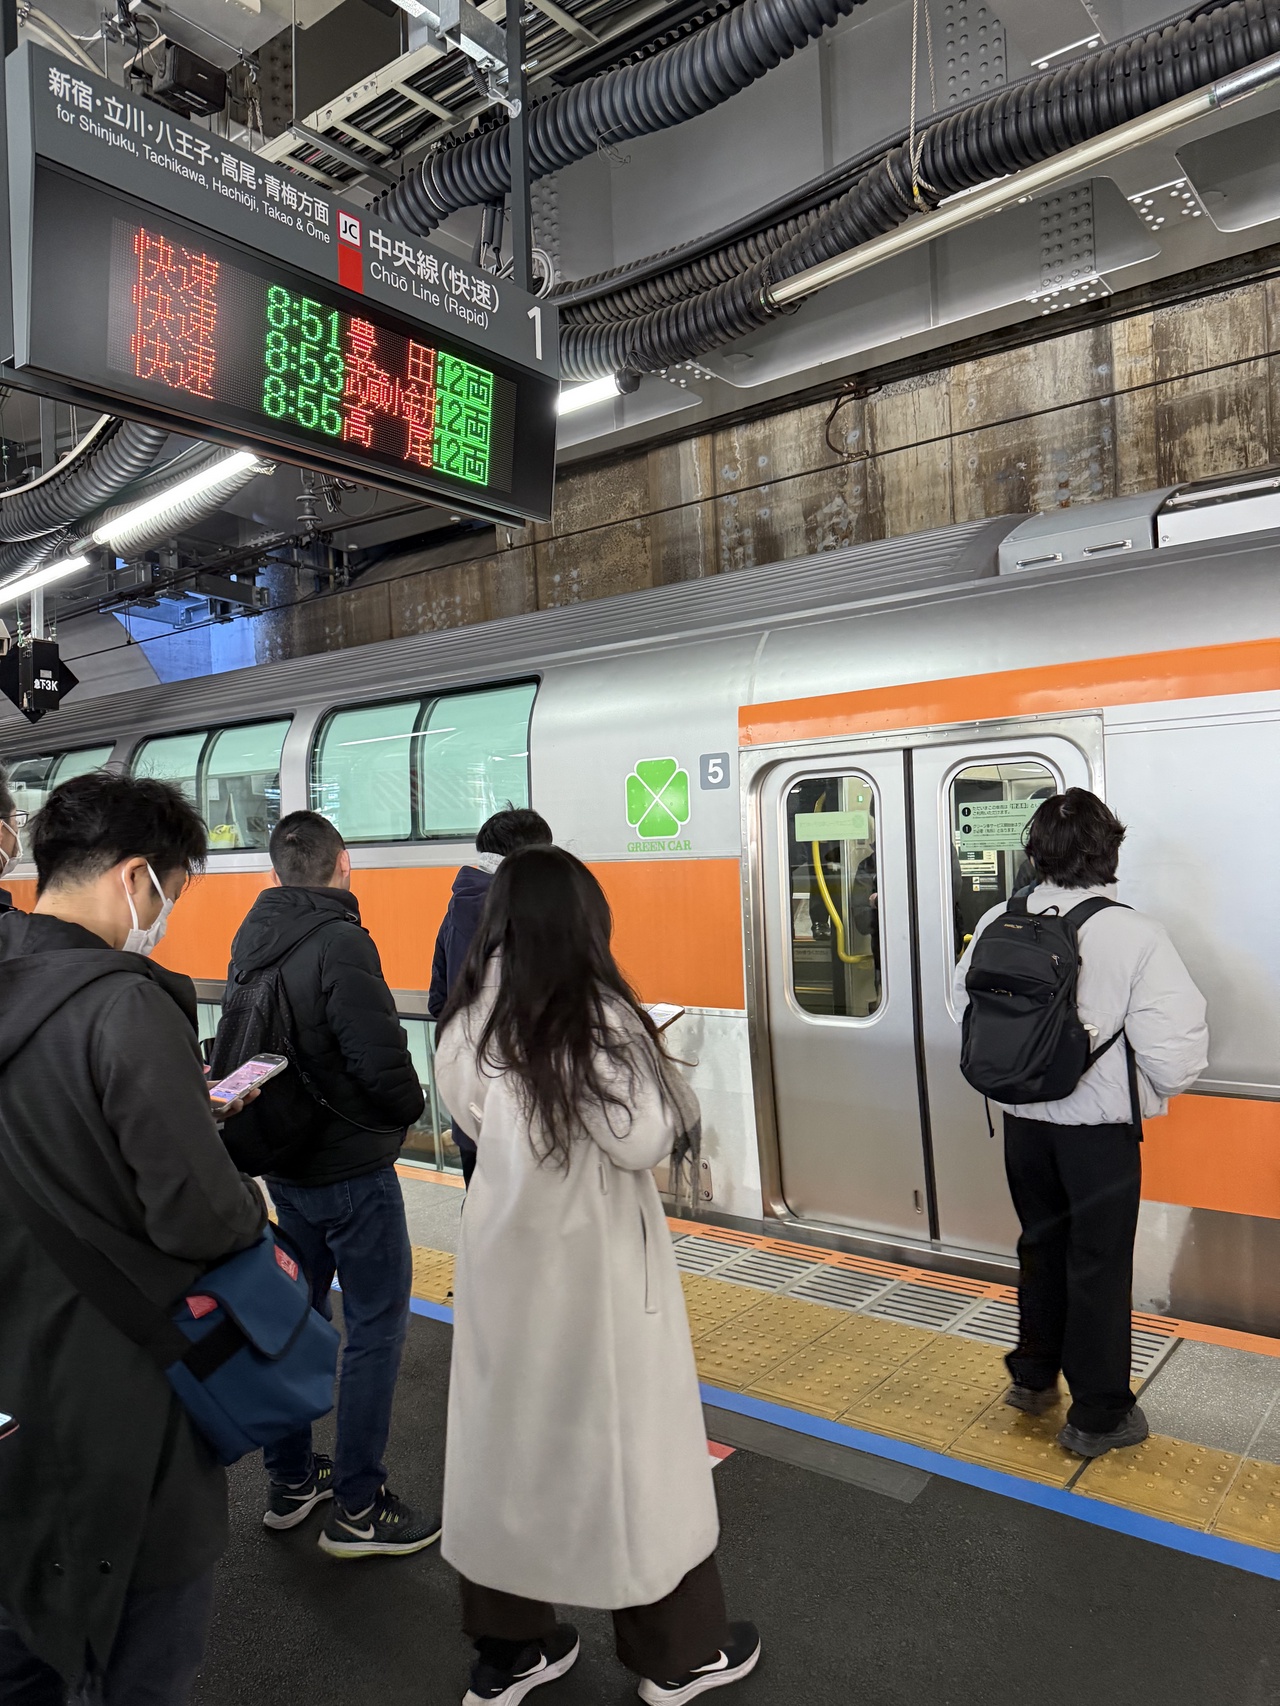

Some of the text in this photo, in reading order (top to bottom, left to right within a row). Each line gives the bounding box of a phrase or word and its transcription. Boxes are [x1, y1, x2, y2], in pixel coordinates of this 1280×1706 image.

[48, 67, 329, 226] 新宿・立川・八王子・高尾・青梅方面
[56, 104, 330, 243] for Shinjuku, Tachikawa, Hachiōji, Takao & Ōme
[342, 220, 358, 240] JC
[134, 228, 220, 306] 快速
[267, 285, 341, 350] 8:51
[437, 354, 493, 407] 12両
[370, 262, 489, 330] Chūō Line (Rapid)
[527, 305, 543, 360] 1
[130, 327, 216, 399] 快速
[263, 375, 342, 436] 8:55
[433, 434, 489, 483] 12両
[132, 278, 218, 353] 快速
[265, 331, 344, 393] 8:53
[435, 395, 491, 446] 12両
[707, 758, 724, 784] 5
[627, 840, 692, 853] GREEN CAR
